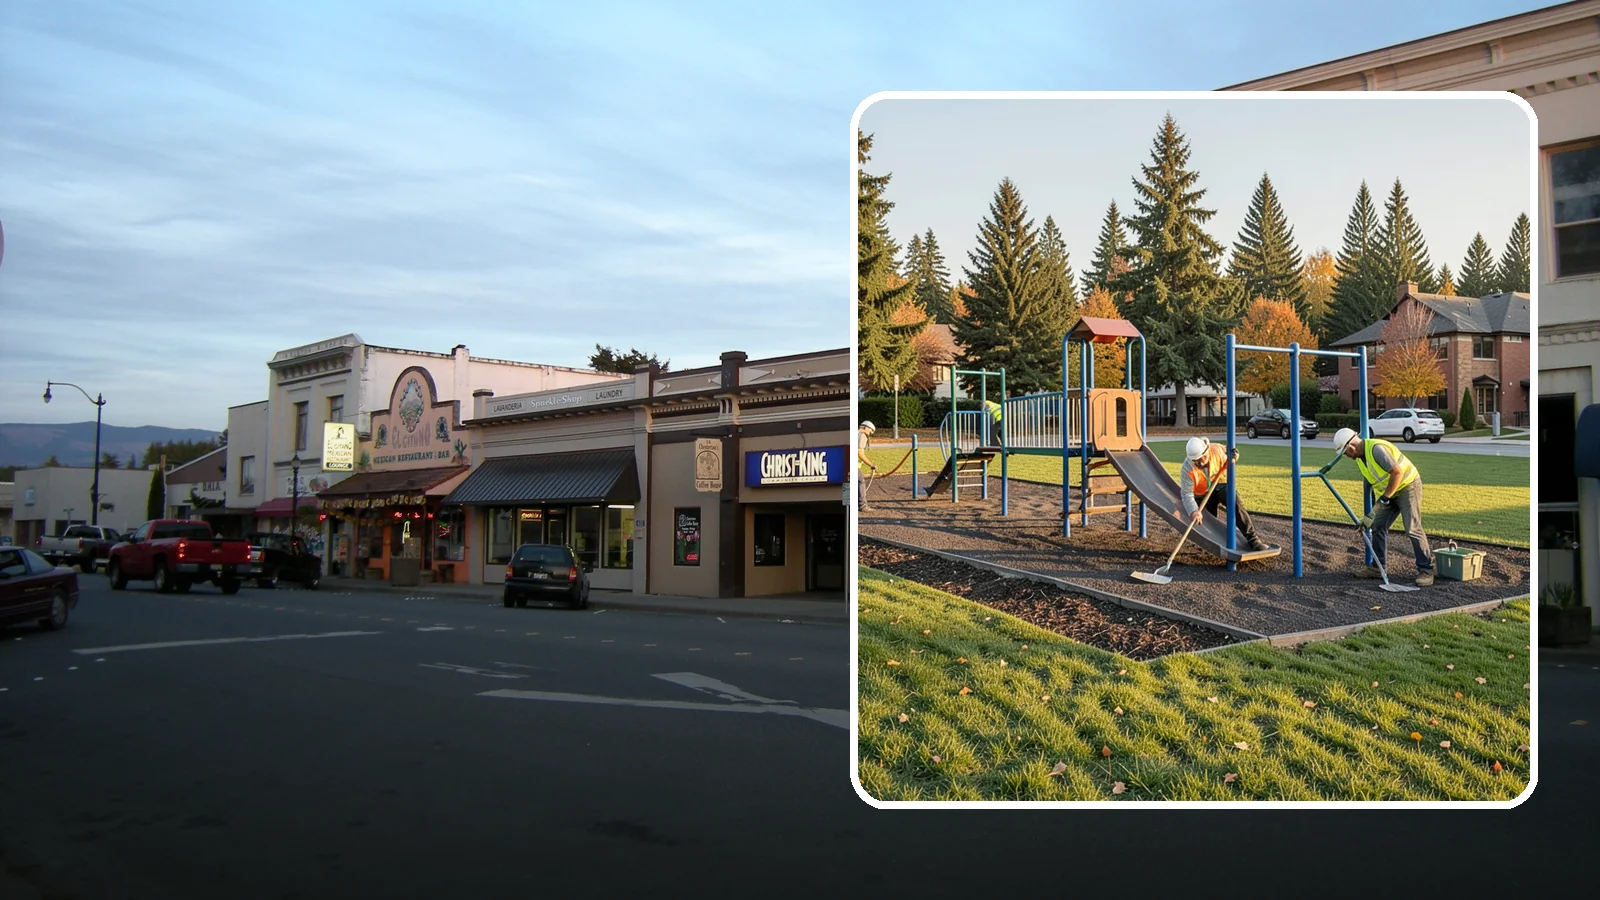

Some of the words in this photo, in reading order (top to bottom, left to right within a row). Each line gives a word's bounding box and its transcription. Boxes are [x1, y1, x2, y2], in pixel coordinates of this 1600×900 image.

[595, 389, 624, 400] LAUNDRY
[530, 397, 561, 409] Sparkle
[561, 394, 583, 405] Shop
[493, 402, 522, 413] LAVANDERIA
[373, 454, 396, 464] MEXICAN
[397, 451, 433, 462] RESTAURANT
[438, 450, 450, 459] BAR
[696, 480, 709, 488] Coffee
